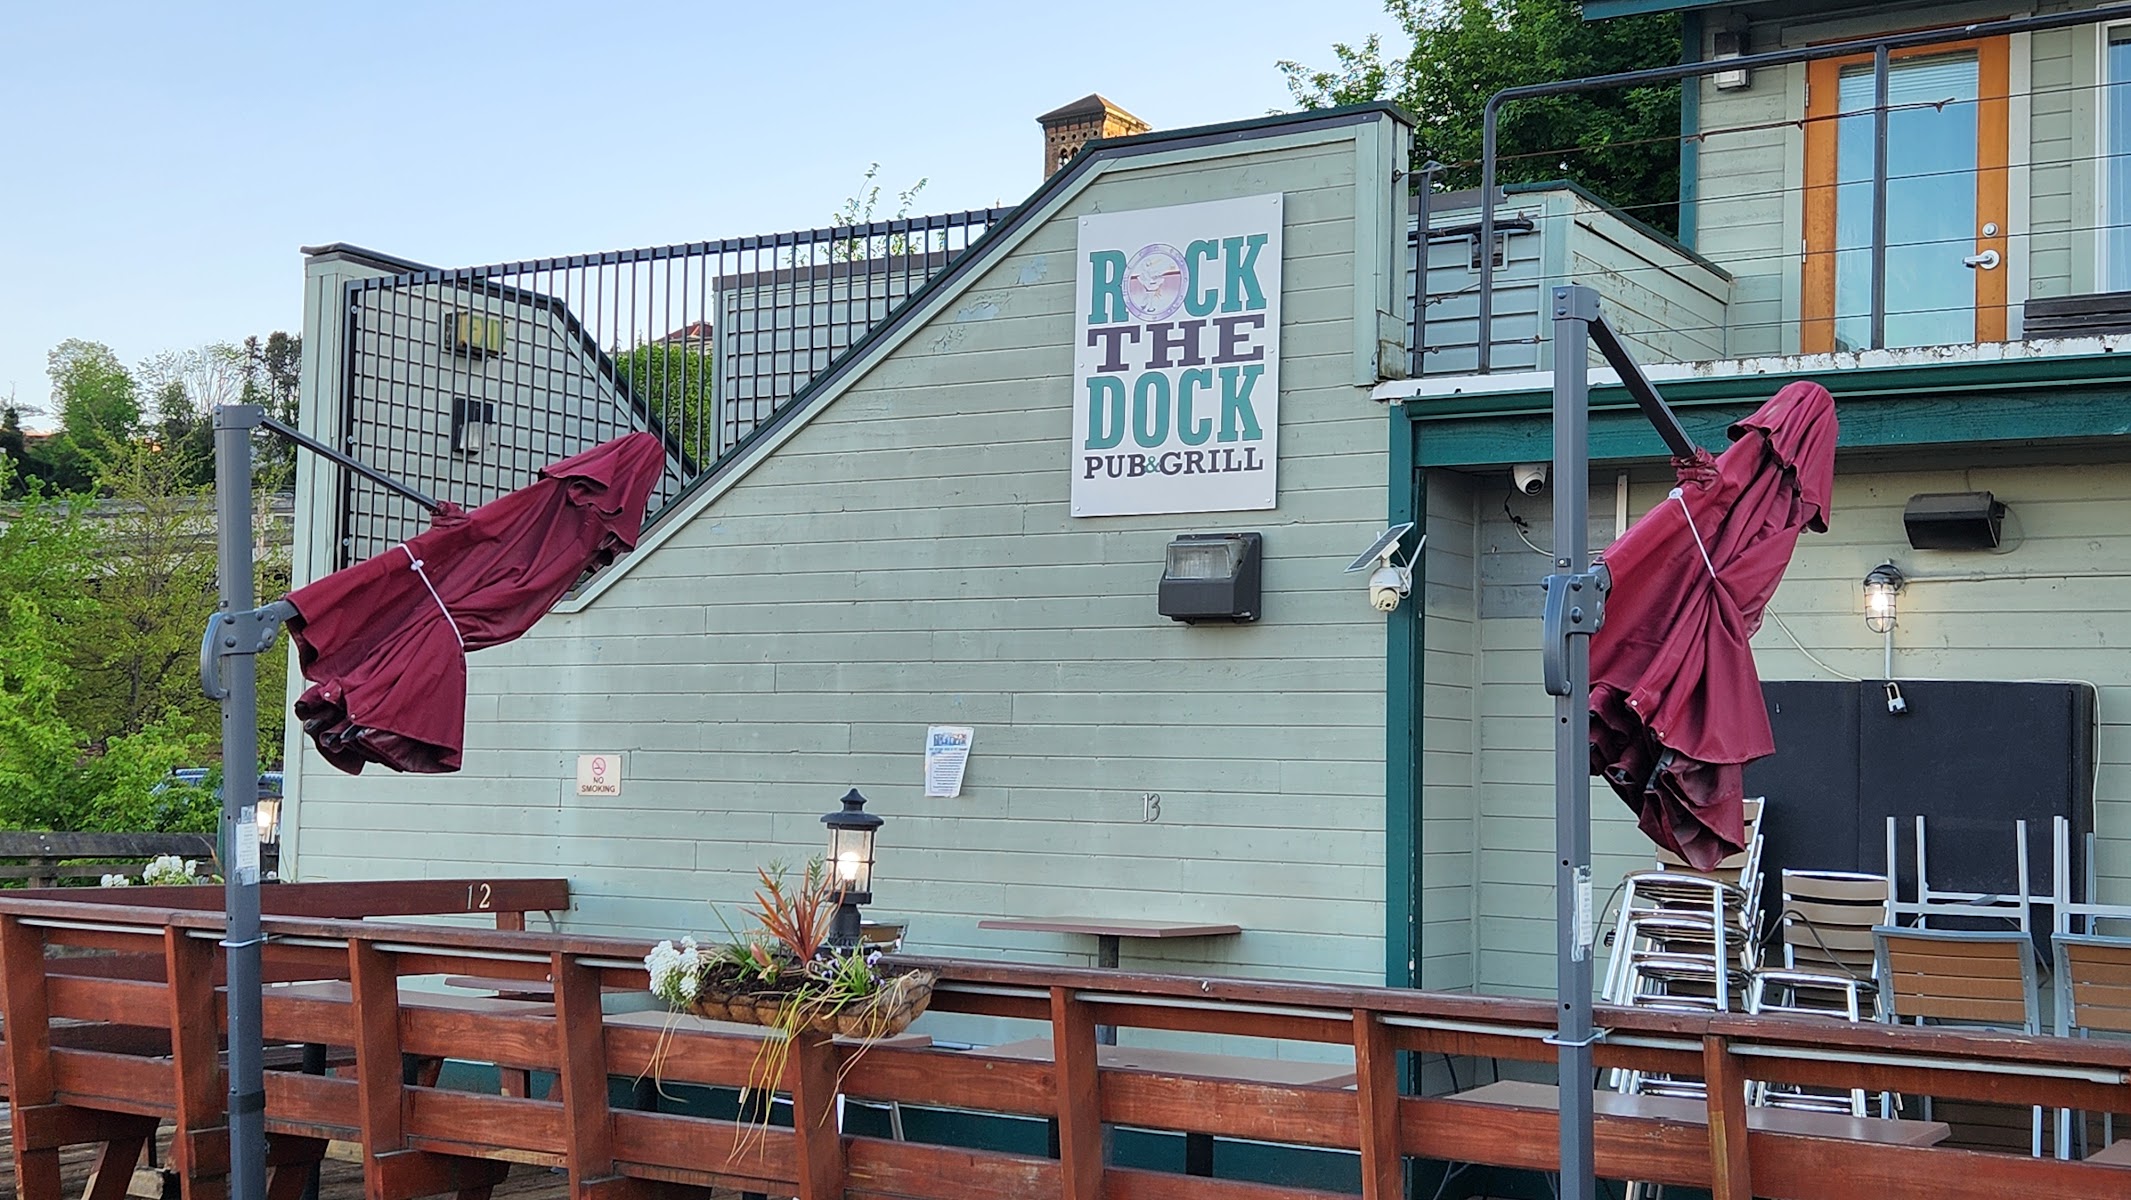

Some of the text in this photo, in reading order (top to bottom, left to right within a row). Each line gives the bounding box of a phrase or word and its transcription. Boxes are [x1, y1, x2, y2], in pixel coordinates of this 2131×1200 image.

[1088, 233, 1268, 325] ROCK
[1087, 313, 1265, 373] THE
[1084, 363, 1264, 450] DOCK
[581, 784, 616, 793] SMOKING
[593, 776, 604, 784] NO
[1142, 792, 1161, 823] 13
[467, 883, 491, 910] 12
